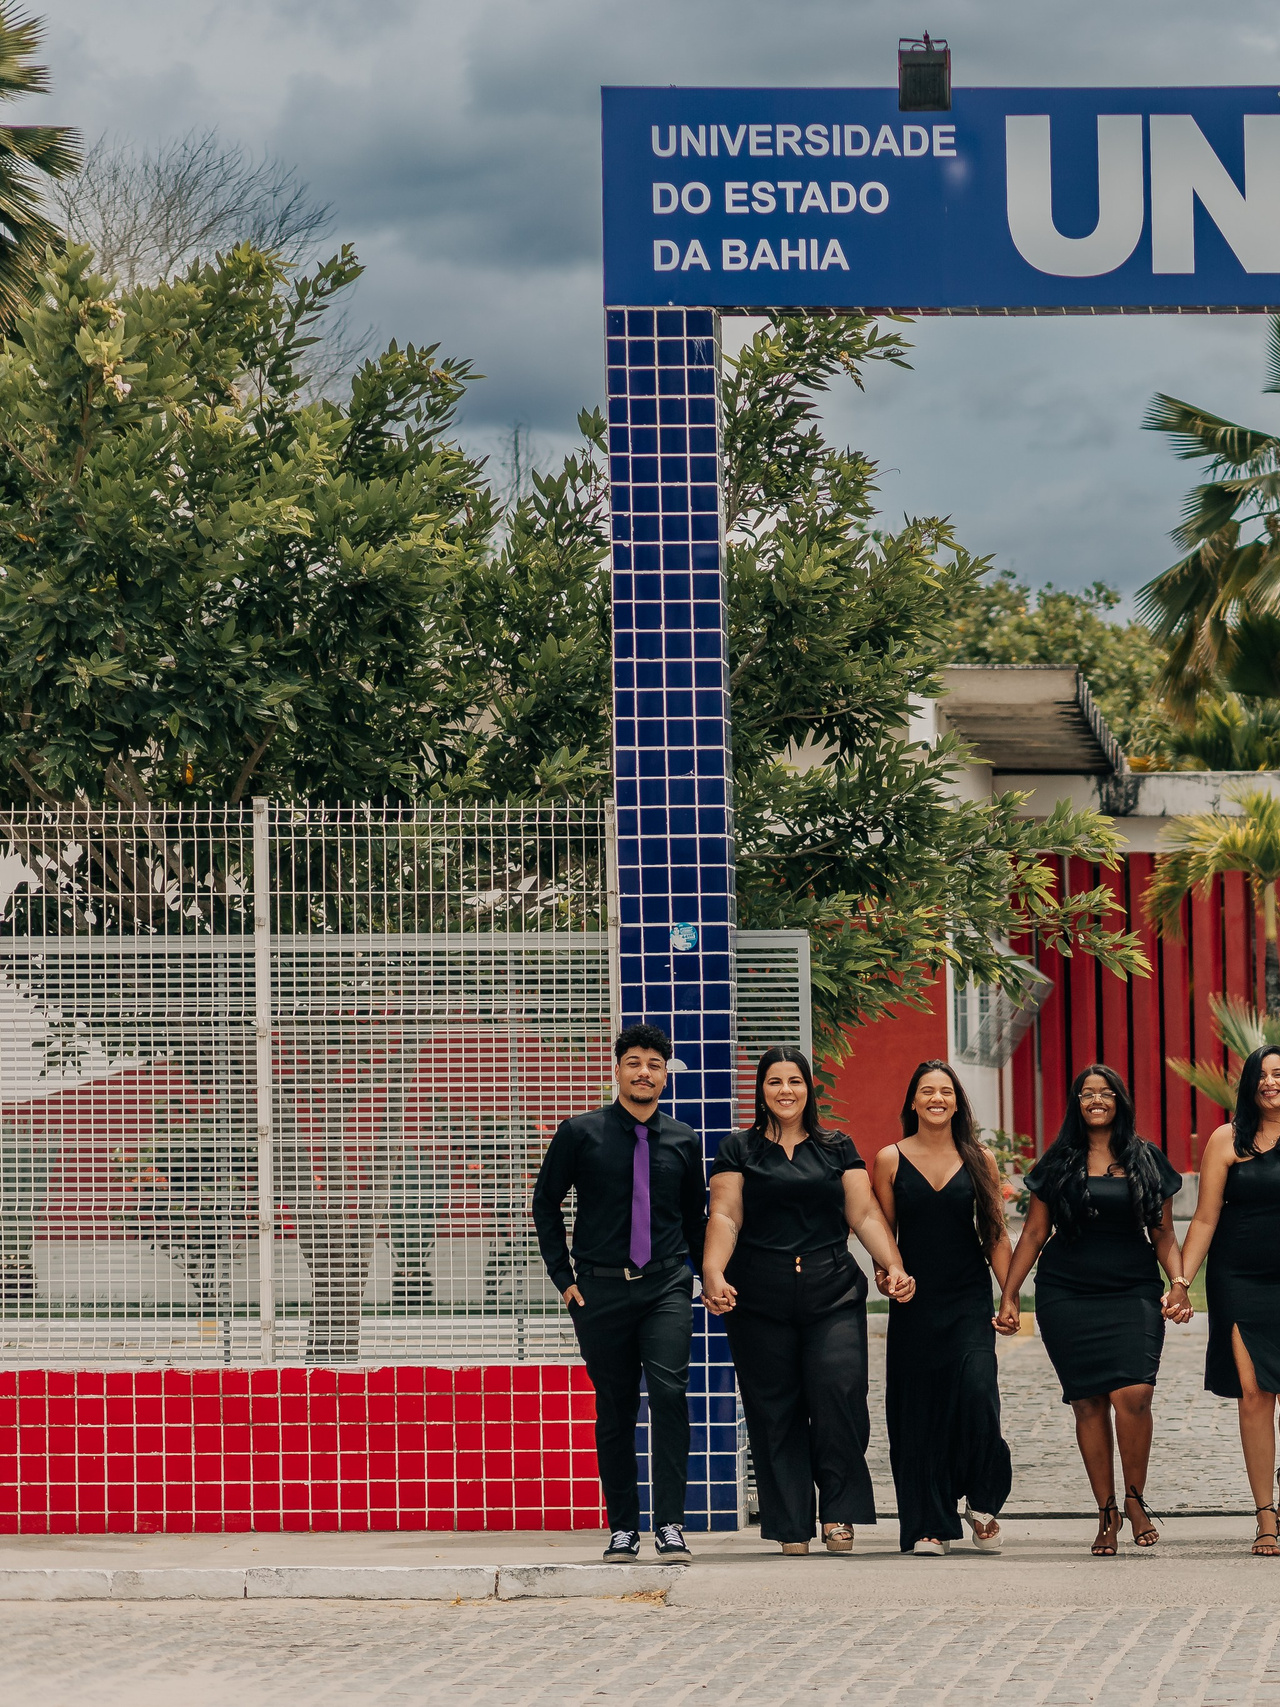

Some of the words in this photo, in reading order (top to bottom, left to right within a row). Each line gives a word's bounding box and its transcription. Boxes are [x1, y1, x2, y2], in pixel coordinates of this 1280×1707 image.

[651, 123, 957, 158] UNIVERSIDADE
[652, 181, 711, 215] DO
[724, 180, 890, 215] ESTADO
[653, 239, 712, 272] DA
[721, 238, 850, 271] BAHIA
